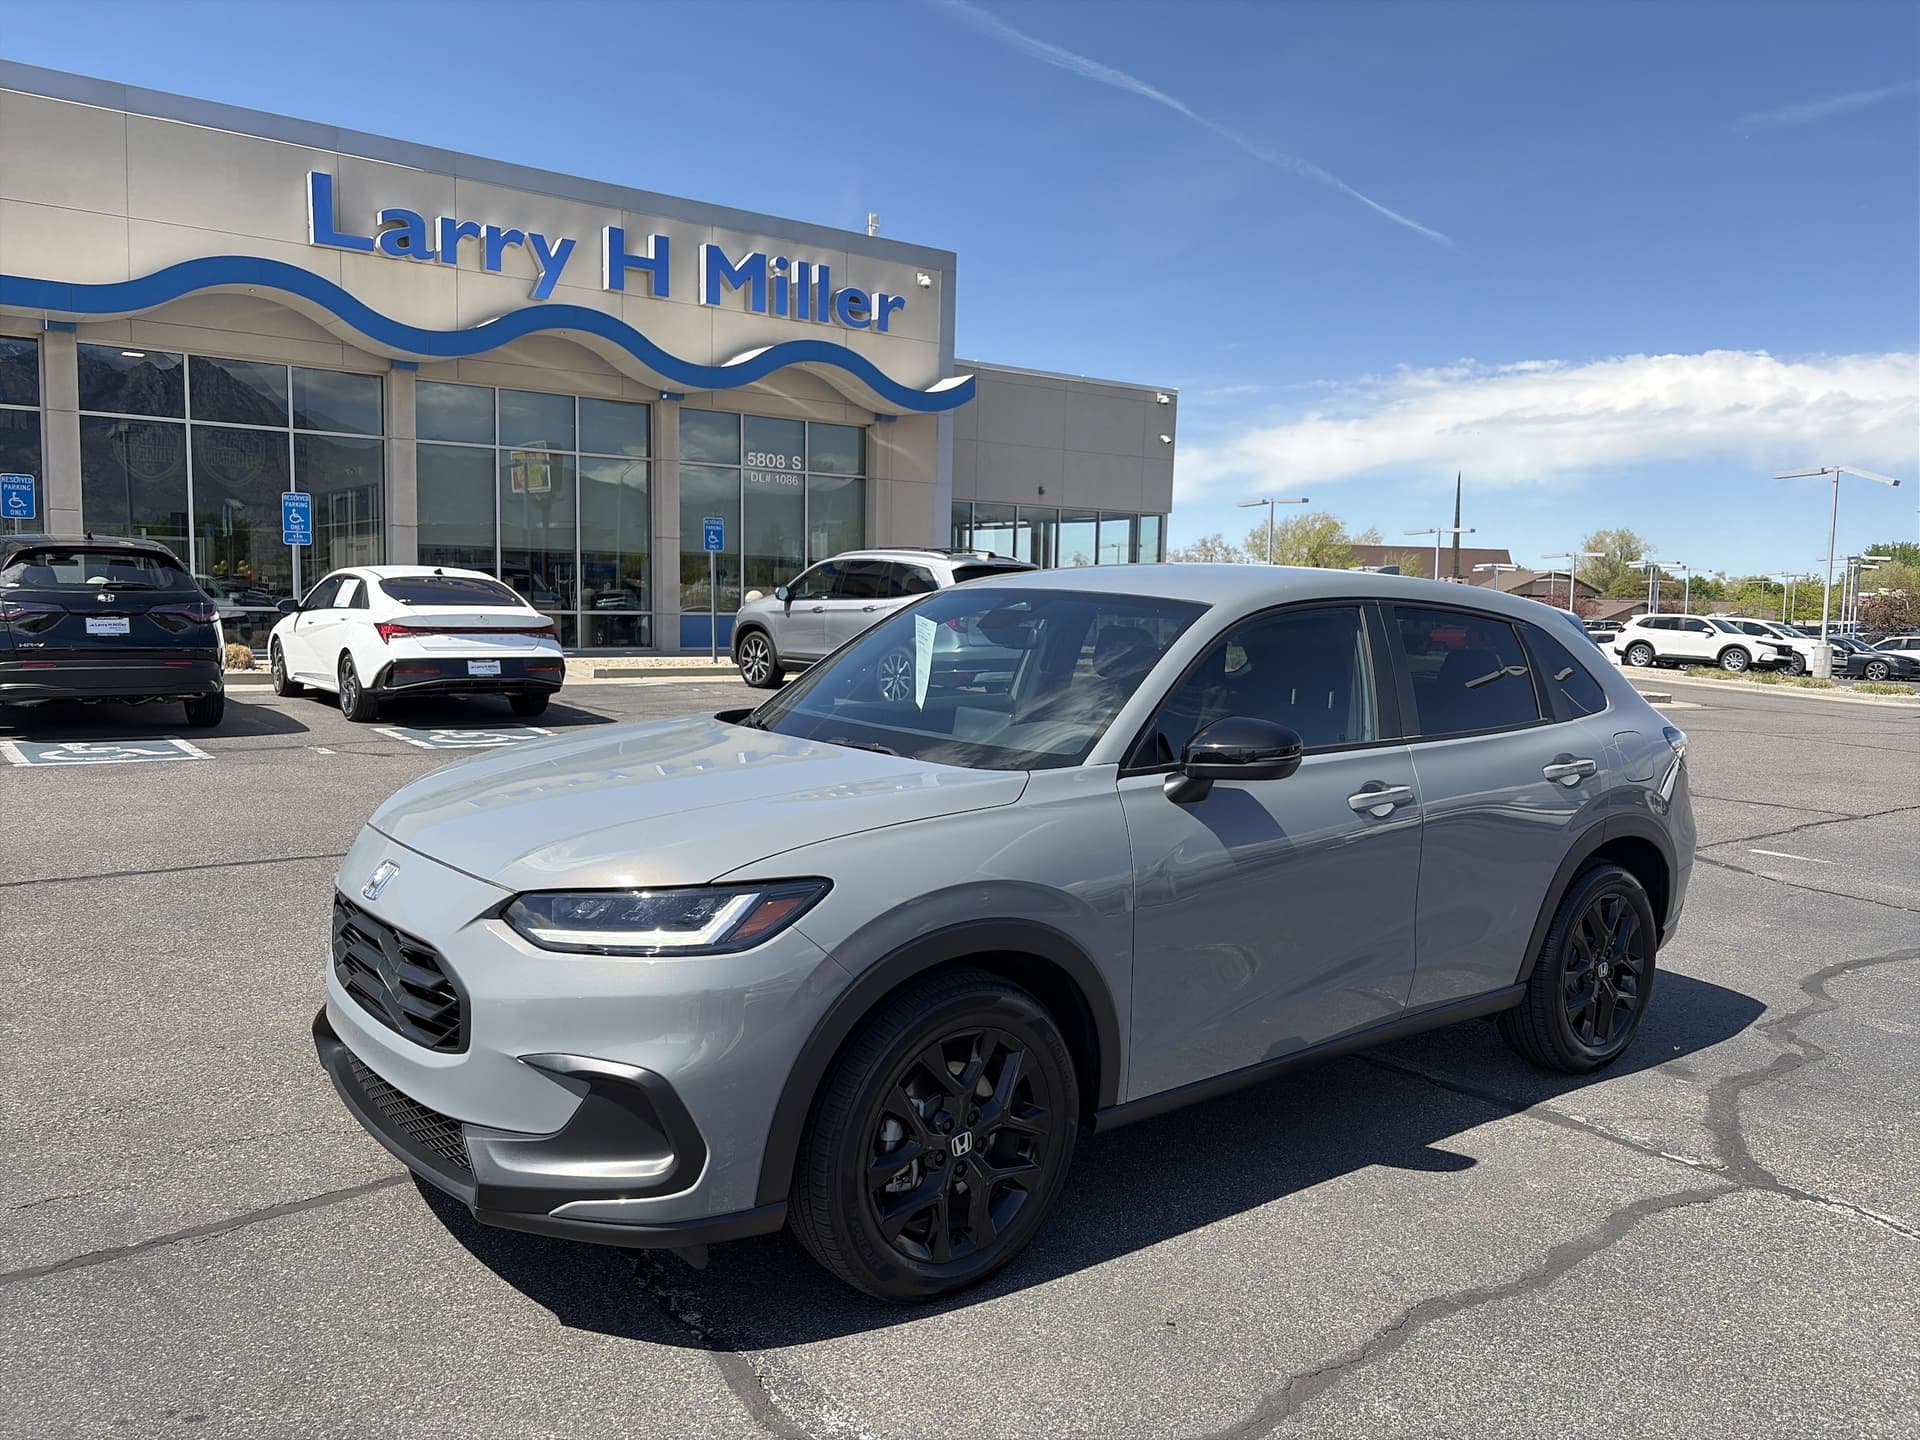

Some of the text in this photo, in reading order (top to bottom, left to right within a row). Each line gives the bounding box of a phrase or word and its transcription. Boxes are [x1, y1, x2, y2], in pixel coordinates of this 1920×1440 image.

[307, 170, 906, 333] Larry H Miller
[747, 452, 802, 470] 5808 S
[775, 474, 799, 486] 1086
